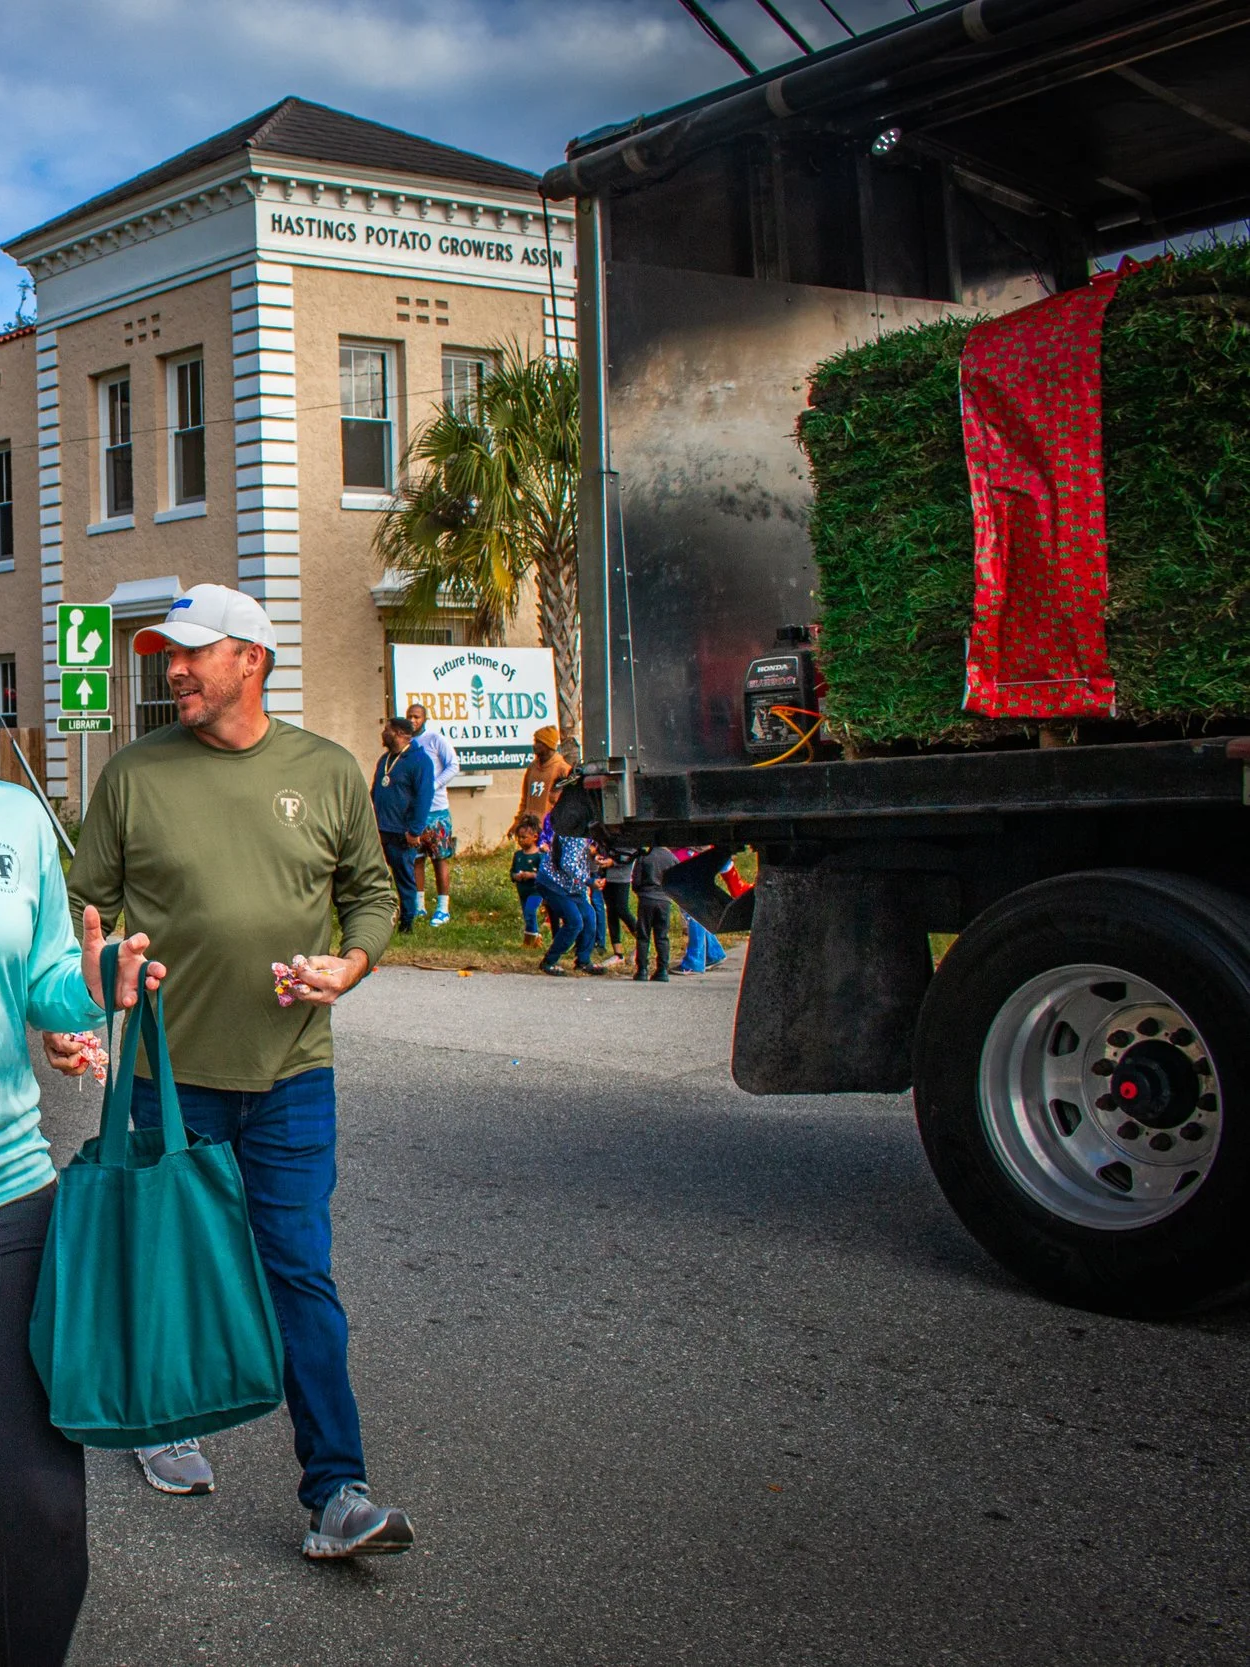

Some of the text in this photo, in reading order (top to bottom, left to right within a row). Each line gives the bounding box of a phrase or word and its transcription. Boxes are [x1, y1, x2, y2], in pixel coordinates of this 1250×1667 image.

[271, 213, 357, 242] HASTINGS
[366, 225, 432, 252] POTATO
[439, 236, 514, 262] GROWERS
[432, 652, 517, 682] Future Home Of
[757, 664, 788, 672] HONDA
[406, 692, 548, 720] FREE KIDS
[69, 720, 100, 730] LIBRARY
